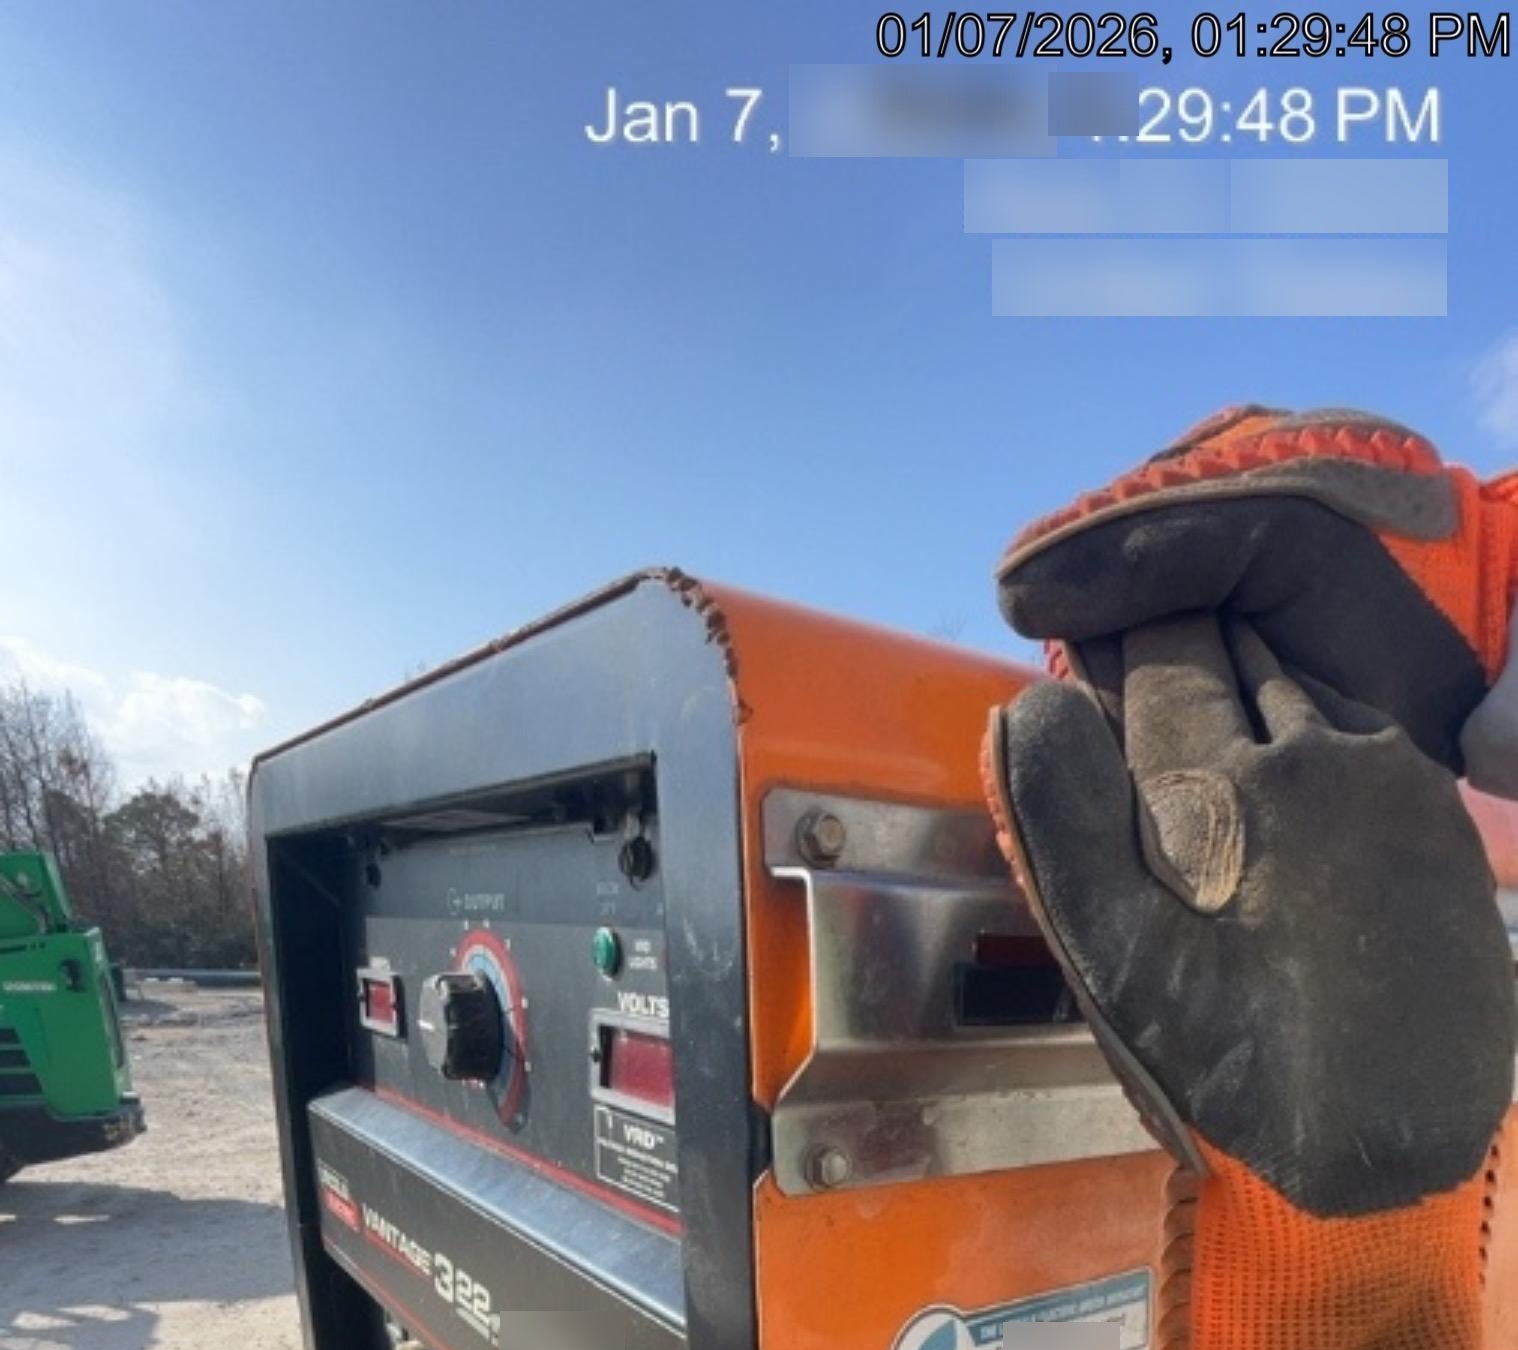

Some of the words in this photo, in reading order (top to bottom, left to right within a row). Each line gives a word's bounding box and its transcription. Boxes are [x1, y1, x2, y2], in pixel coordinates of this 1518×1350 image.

[617, 990, 669, 1018] VOLTS
[362, 1203, 432, 1275] VANTAGE
[434, 1252, 490, 1326] 322
